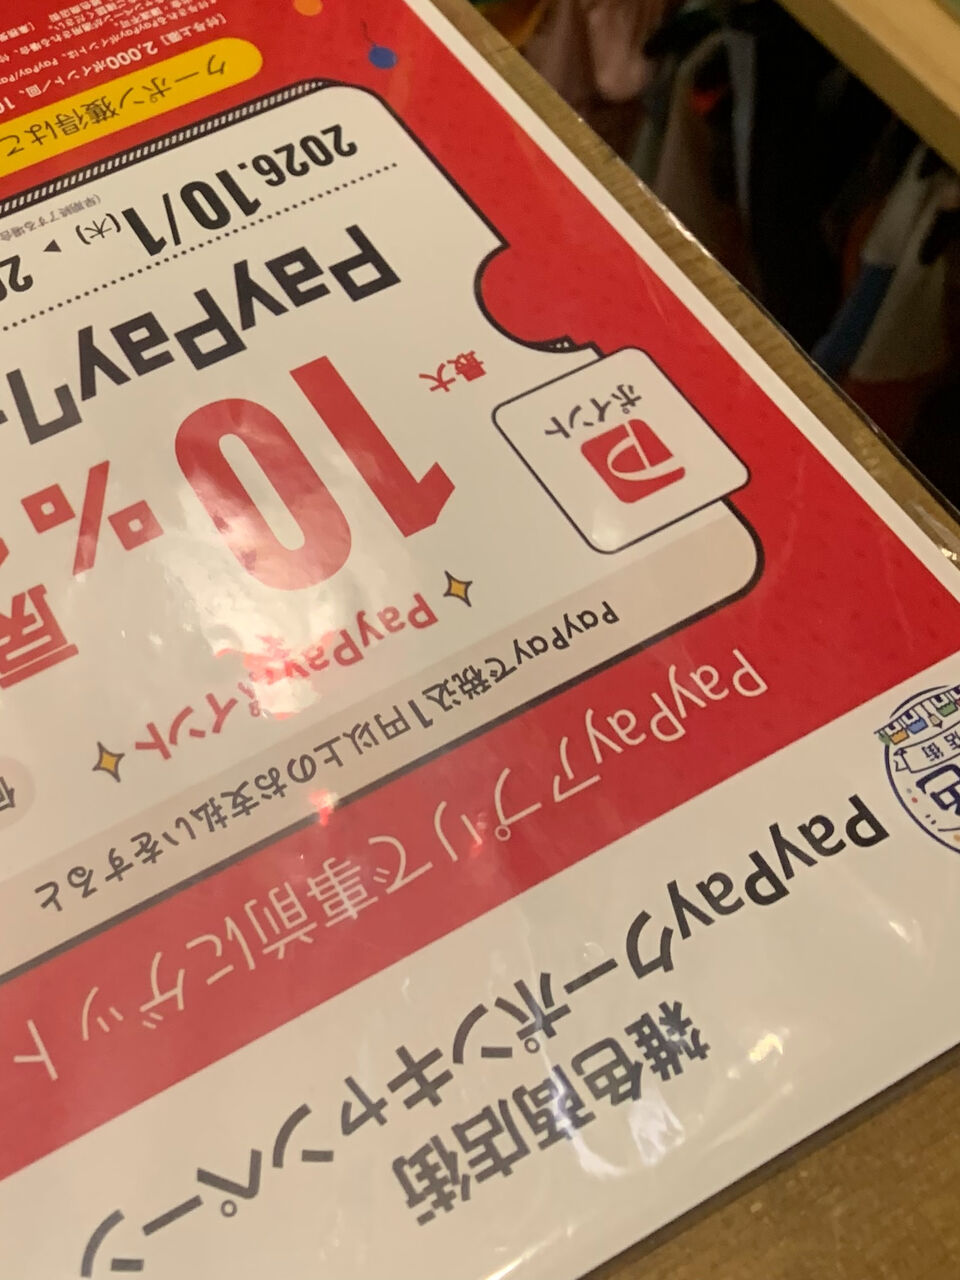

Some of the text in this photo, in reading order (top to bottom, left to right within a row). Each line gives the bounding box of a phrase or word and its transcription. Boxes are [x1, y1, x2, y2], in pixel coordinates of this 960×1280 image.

[419, 350, 487, 393] 最大
[545, 384, 642, 439] ポイント
[35, 599, 620, 913] PayPayで税込1円以上のお支払いをすると
[80, 794, 890, 1280] PayPayクーポンキャンペーン
[392, 1000, 713, 1228] 雑色商店街
